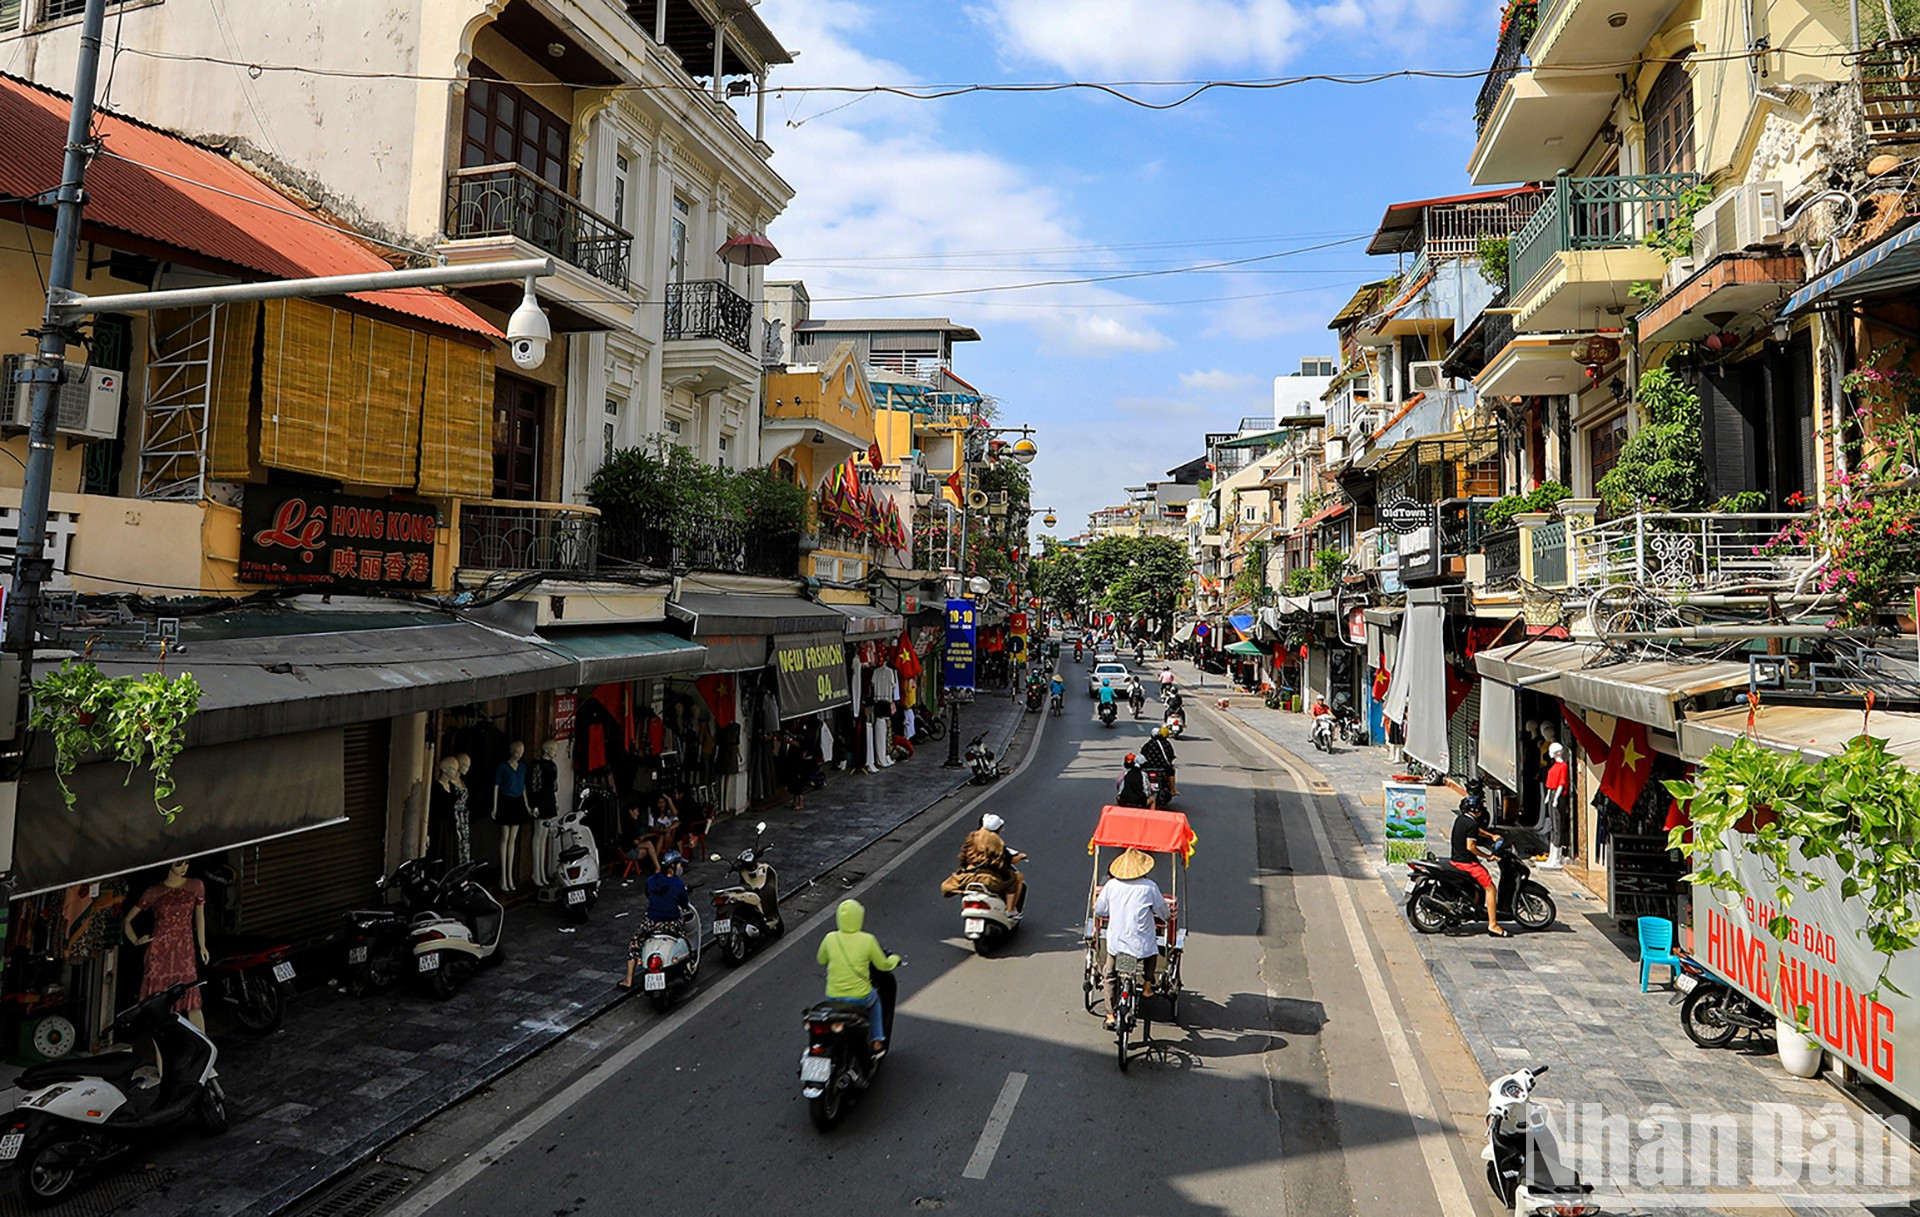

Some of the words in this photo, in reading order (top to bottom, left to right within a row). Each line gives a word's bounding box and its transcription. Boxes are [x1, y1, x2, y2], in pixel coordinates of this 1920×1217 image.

[332, 505, 384, 539] HONG
[386, 511, 436, 544] KONG
[1382, 508, 1427, 518] OldTown
[332, 547, 431, 582] 映丽香港
[779, 649, 804, 673] NEW
[805, 643, 843, 669] FASHION
[817, 673, 833, 702] 94
[1802, 921, 1837, 965] ĐÀO
[1778, 949, 1894, 1083] NHUNG
